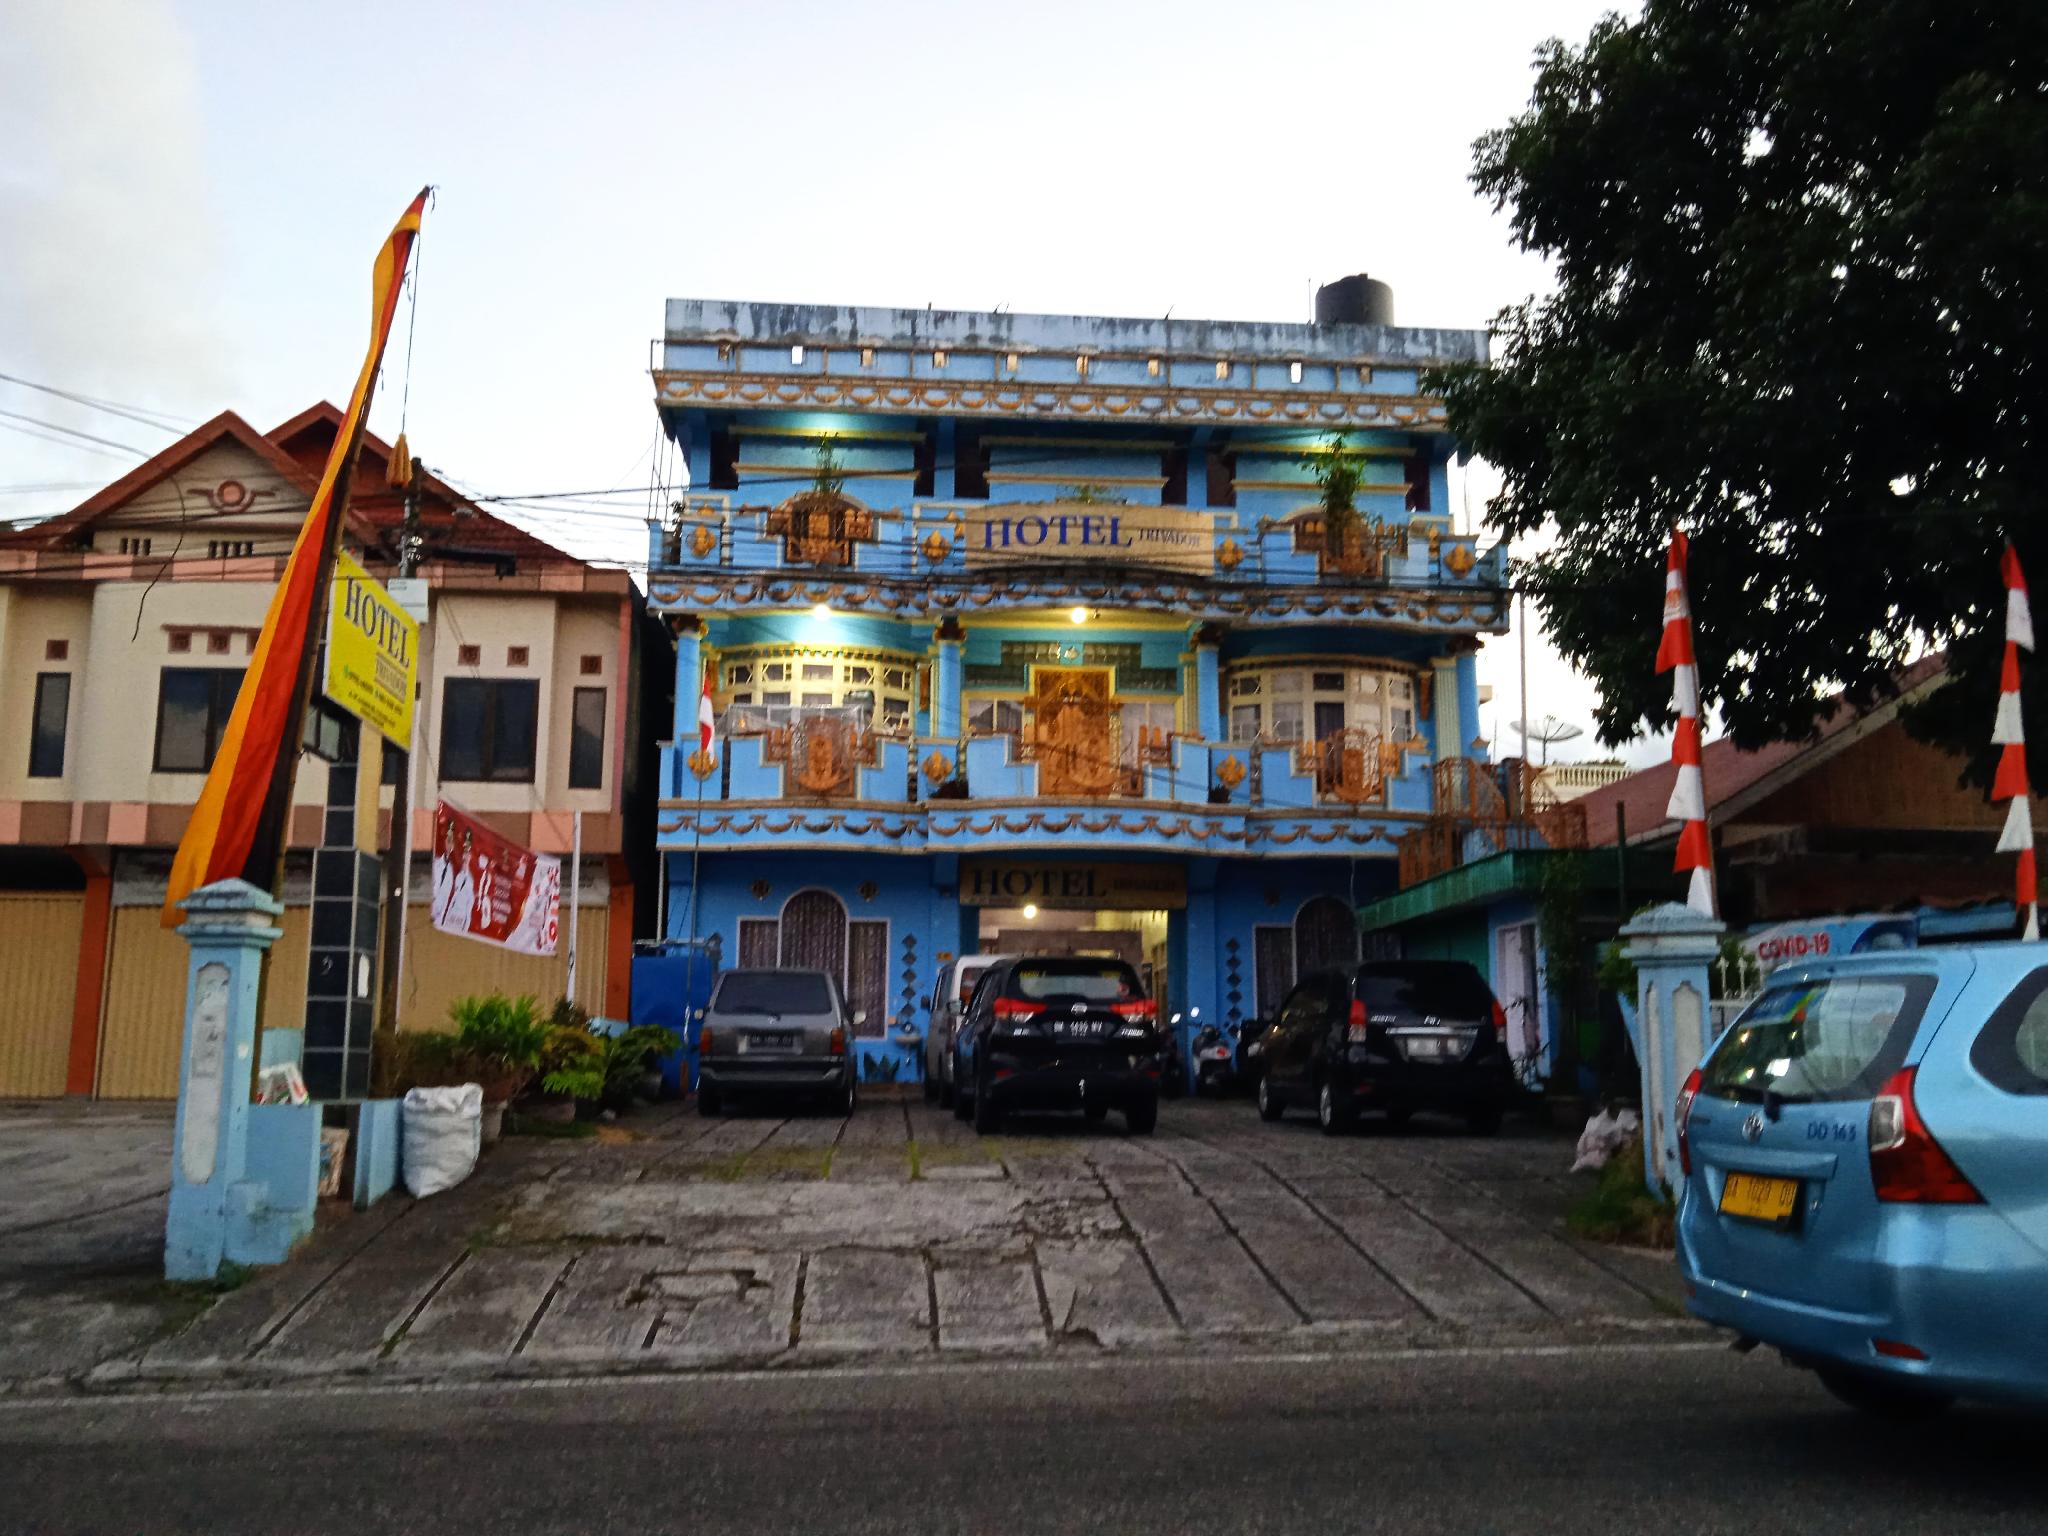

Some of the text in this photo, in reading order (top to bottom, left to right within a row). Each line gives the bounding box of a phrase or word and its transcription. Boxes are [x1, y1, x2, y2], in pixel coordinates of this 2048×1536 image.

[984, 515, 1133, 549] HOTEL
[343, 575, 410, 669] HOTEL
[971, 868, 1107, 898] HOTEL
[1758, 932, 1831, 961] COVID-19
